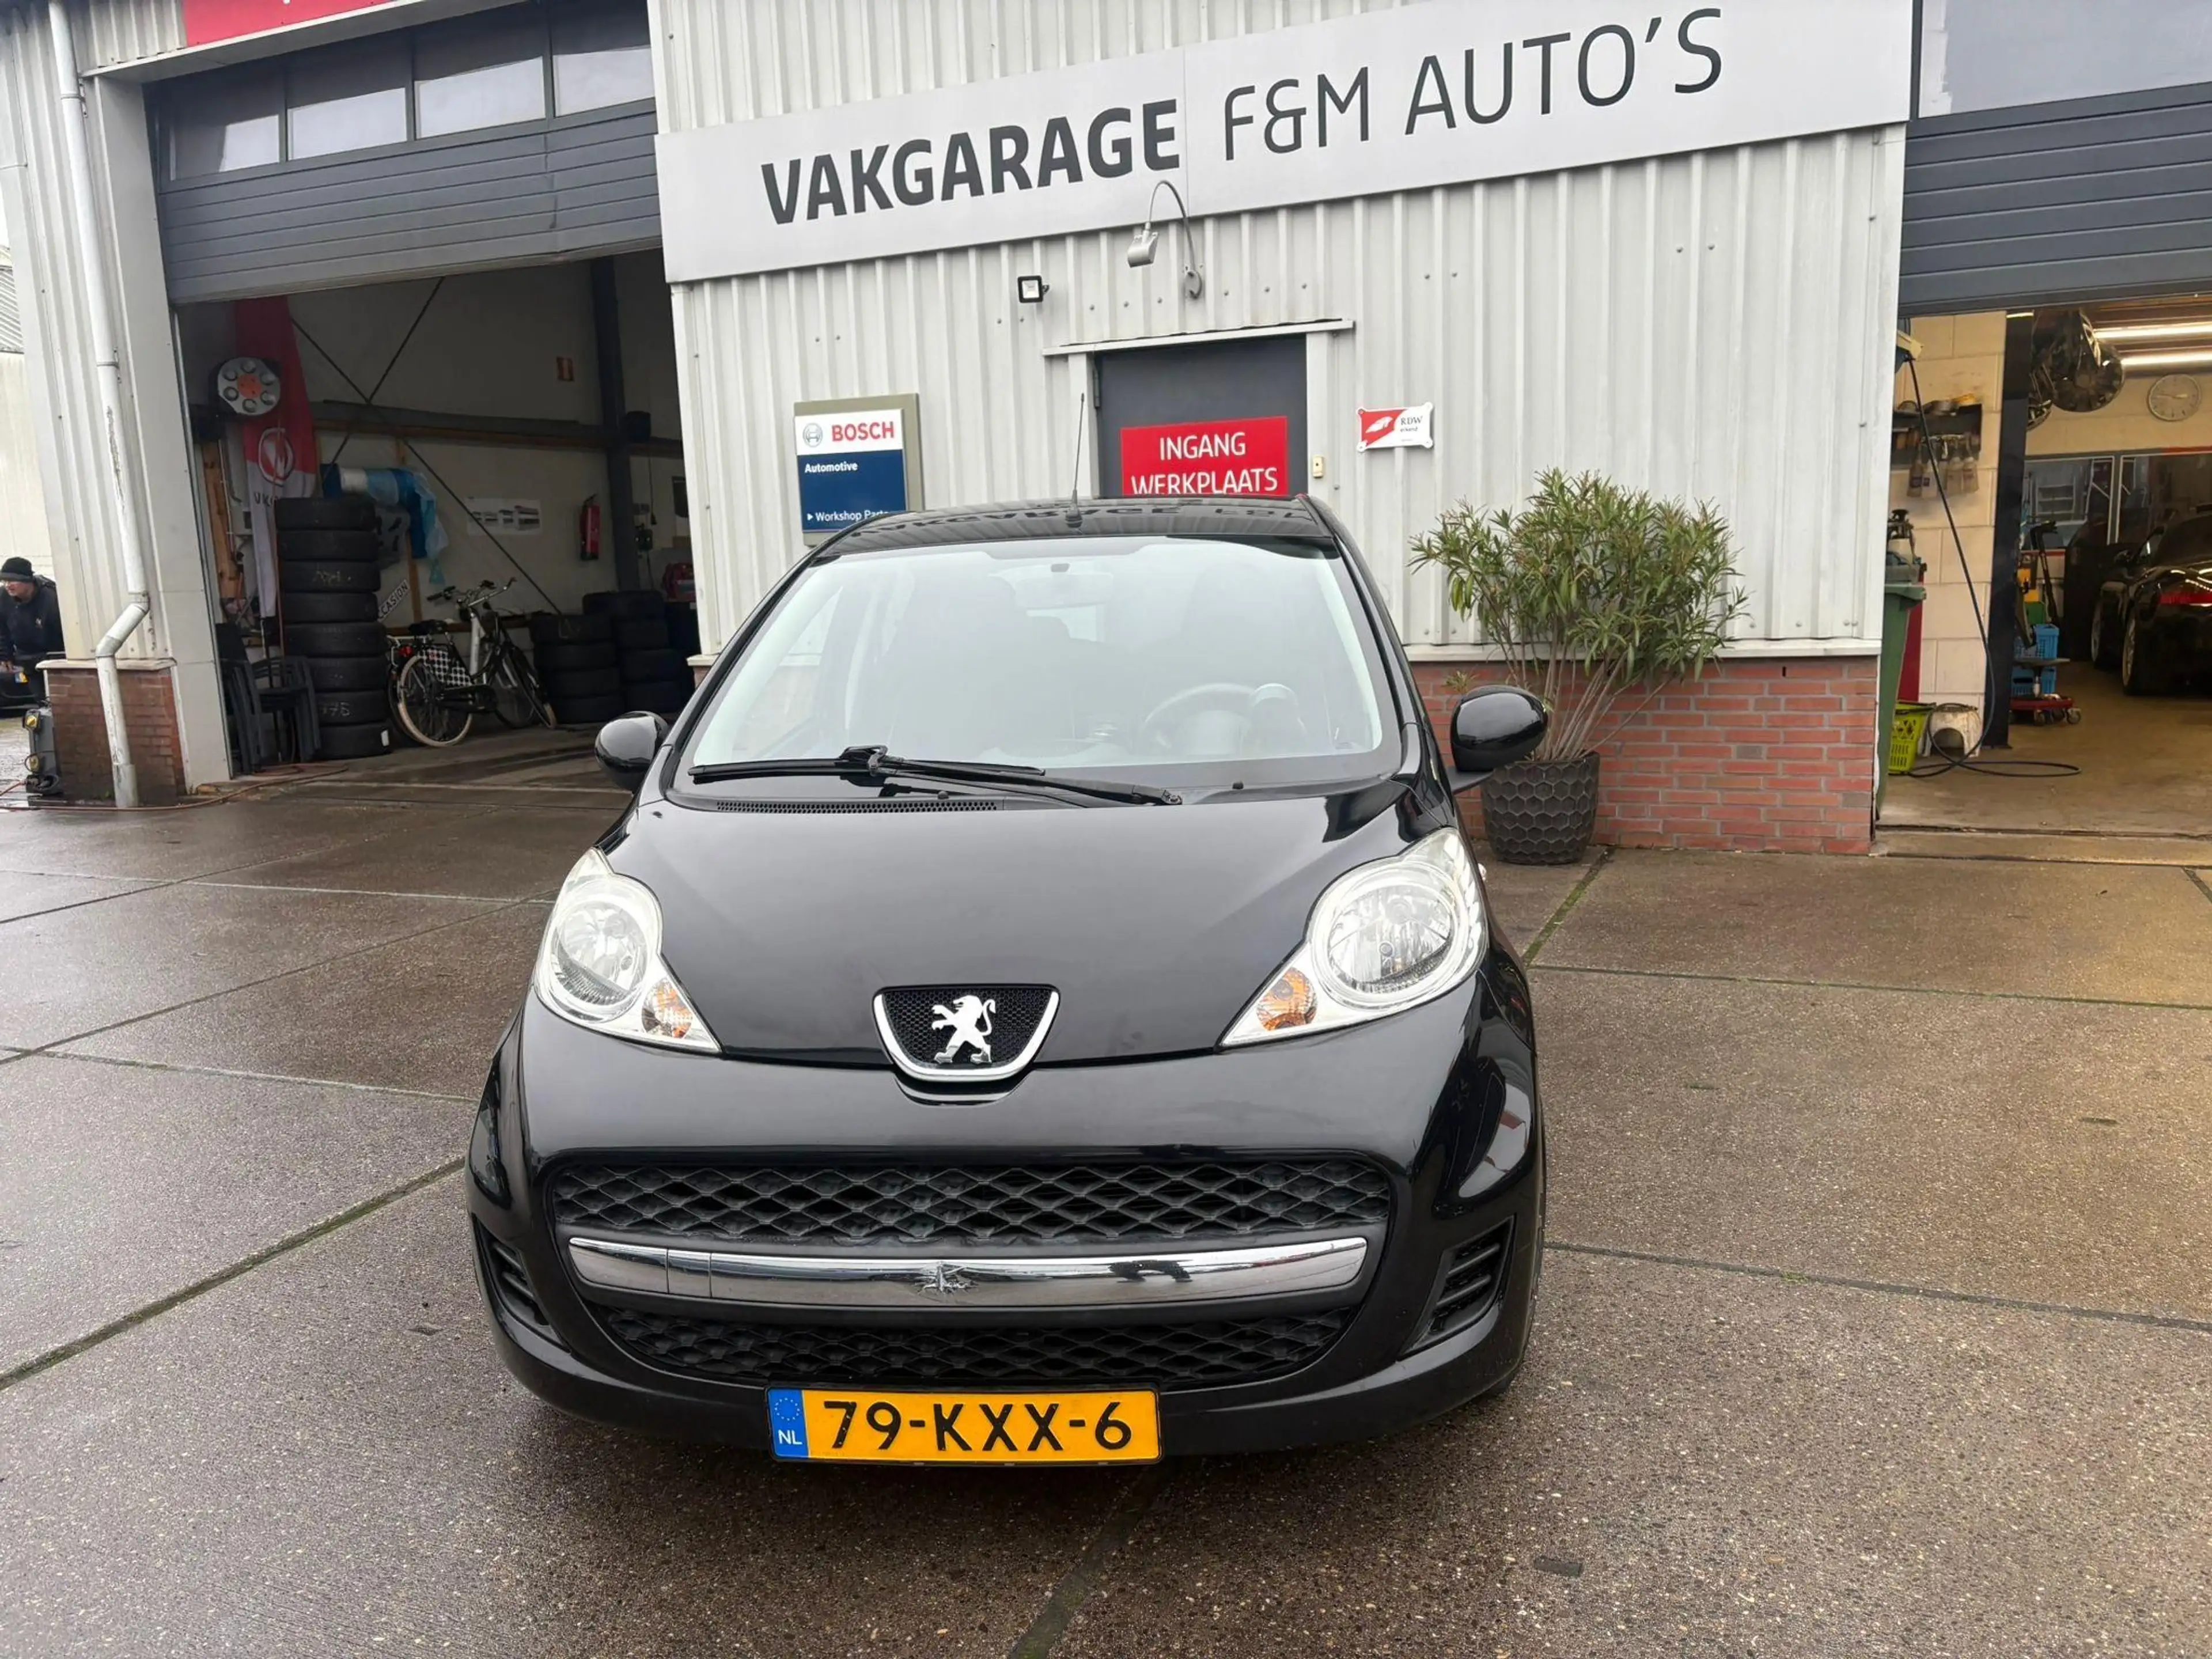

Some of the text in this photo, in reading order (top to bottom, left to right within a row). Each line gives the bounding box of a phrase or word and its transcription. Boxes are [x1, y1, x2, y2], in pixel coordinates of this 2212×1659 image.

[761, 8, 1722, 225] VAKGARAGE F&M AUTO'S
[1400, 415, 1423, 426] RDW
[831, 421, 895, 442] BOSCH
[1160, 432, 1246, 461] INGANG
[804, 461, 858, 473] Automotive
[1131, 467, 1278, 495] WERKPLAATS
[815, 510, 862, 521] Workshop
[823, 1401, 1132, 1451] 79-KXX-6
[778, 1430, 803, 1445] NL
